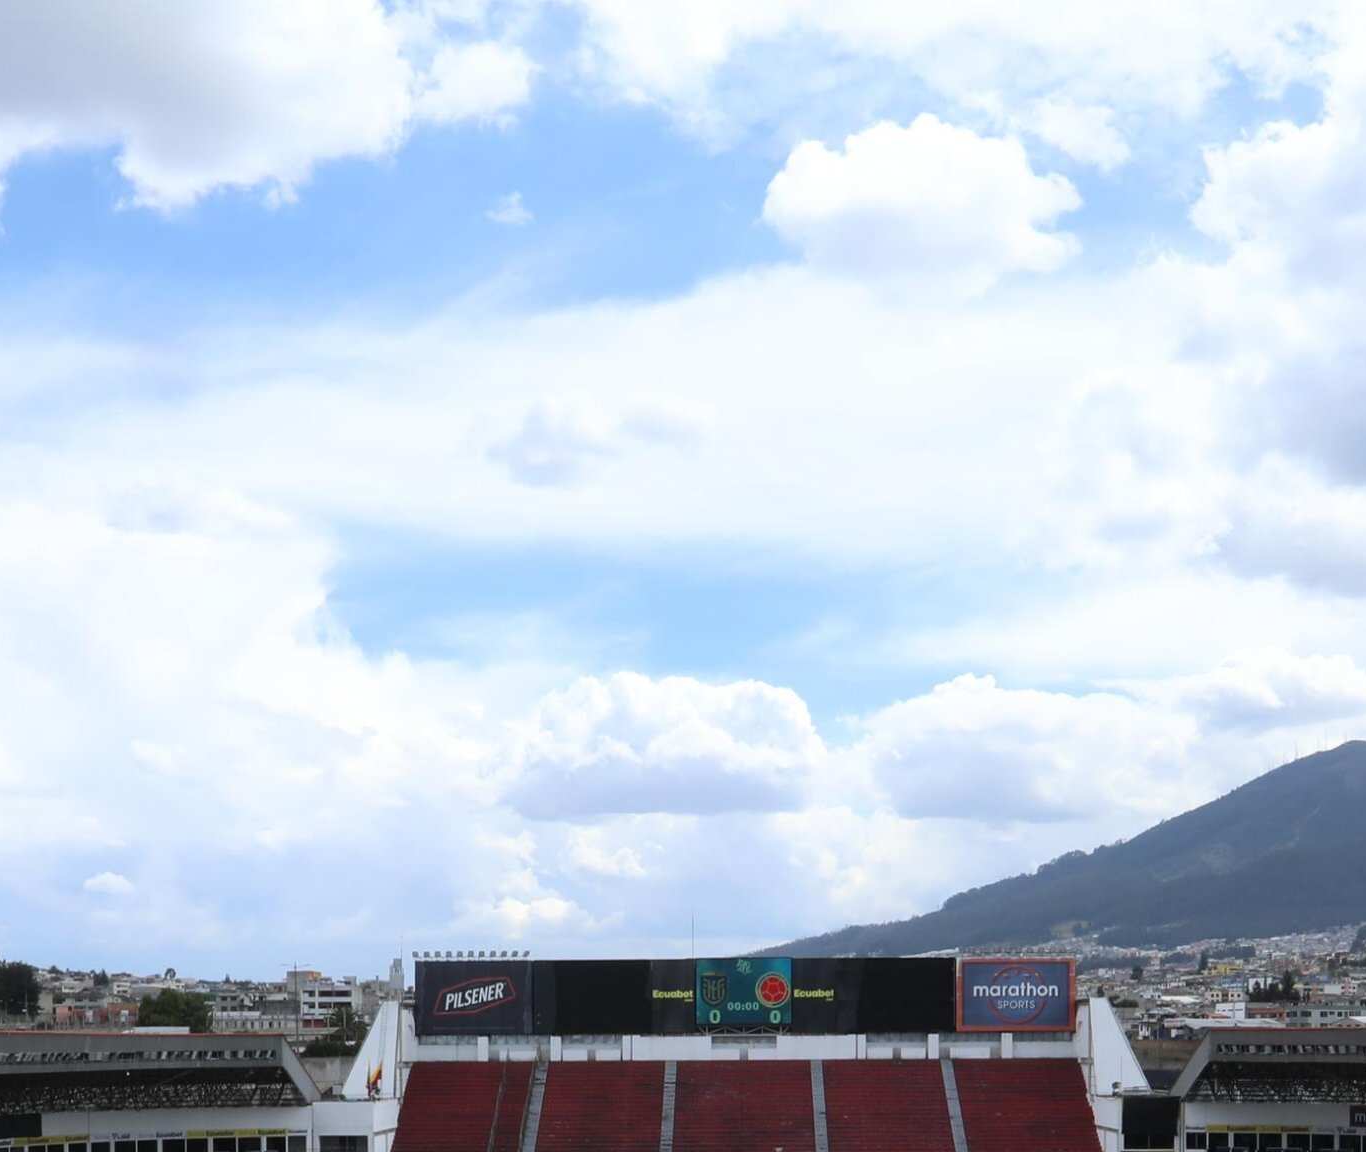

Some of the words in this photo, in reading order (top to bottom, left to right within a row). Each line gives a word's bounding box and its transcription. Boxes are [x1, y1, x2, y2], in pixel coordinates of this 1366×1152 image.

[652, 989, 693, 999] Ecuabet
[794, 988, 834, 998] Ecuabet
[973, 982, 1059, 997] marathon
[445, 982, 504, 1011] PILSENER
[727, 1002, 759, 1011] 00:00
[997, 1000, 1036, 1010] SPORTS
[709, 1010, 721, 1024] 0
[769, 1010, 781, 1024] 0
